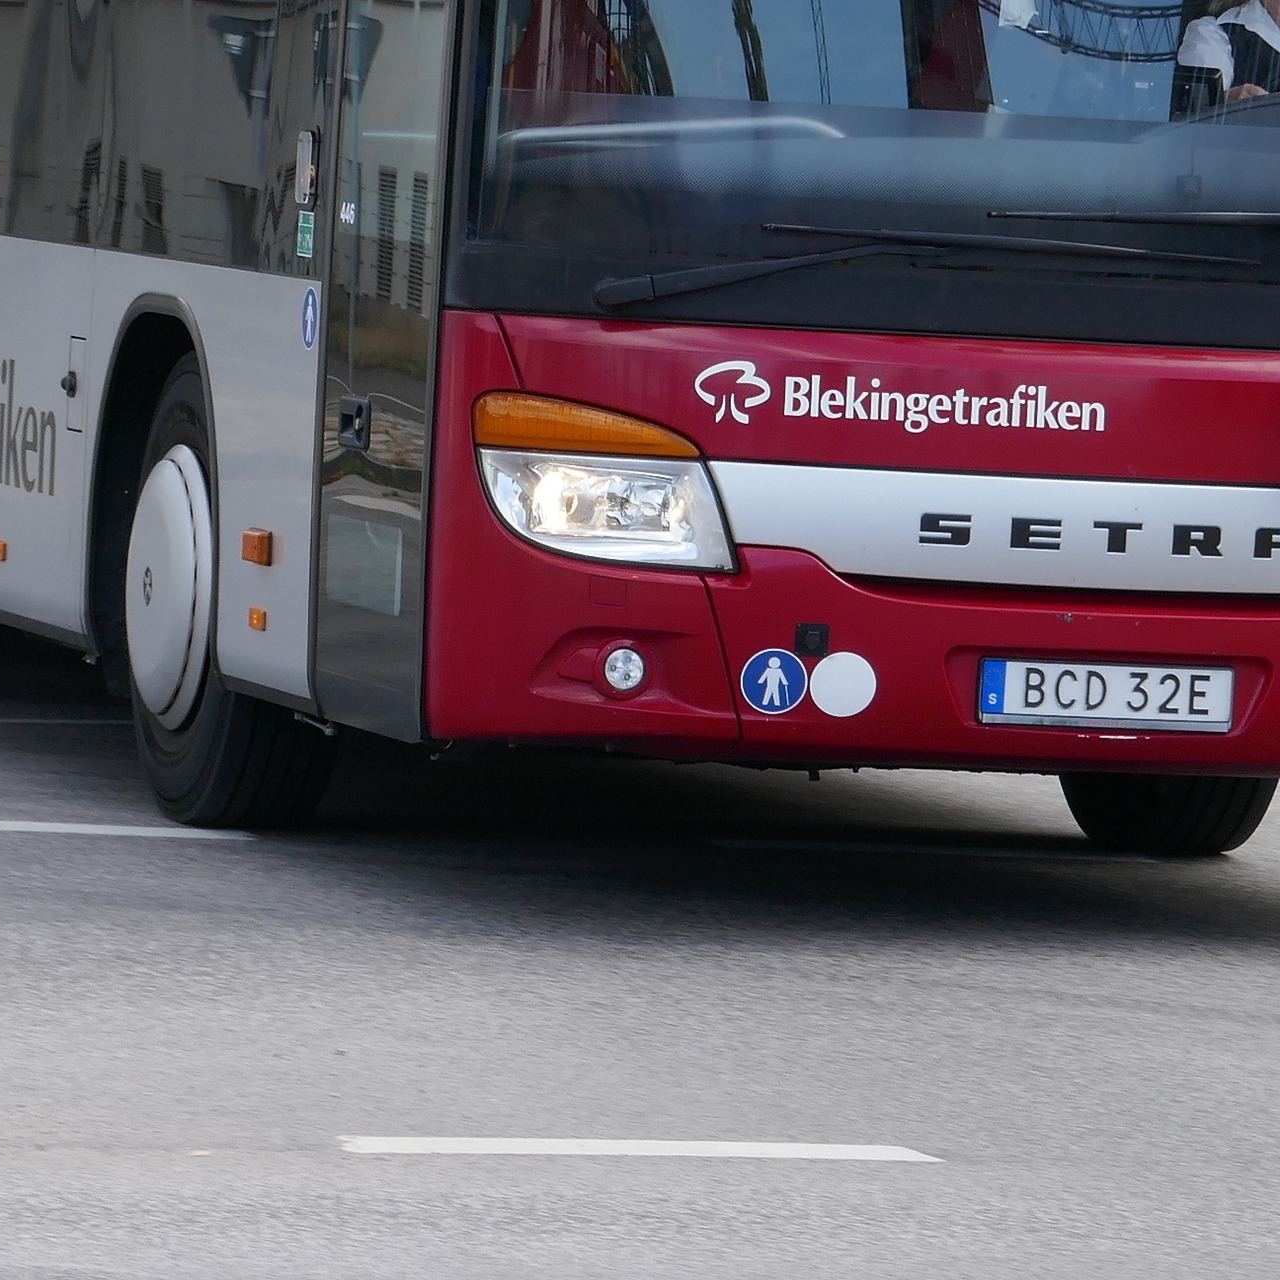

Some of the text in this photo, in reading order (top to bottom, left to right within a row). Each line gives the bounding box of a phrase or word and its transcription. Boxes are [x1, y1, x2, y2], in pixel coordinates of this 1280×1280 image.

[340, 202, 356, 225] 446
[783, 374, 1105, 433] Blekingetrafiken
[988, 693, 998, 705] S
[1024, 667, 1211, 715] BCD 32E
